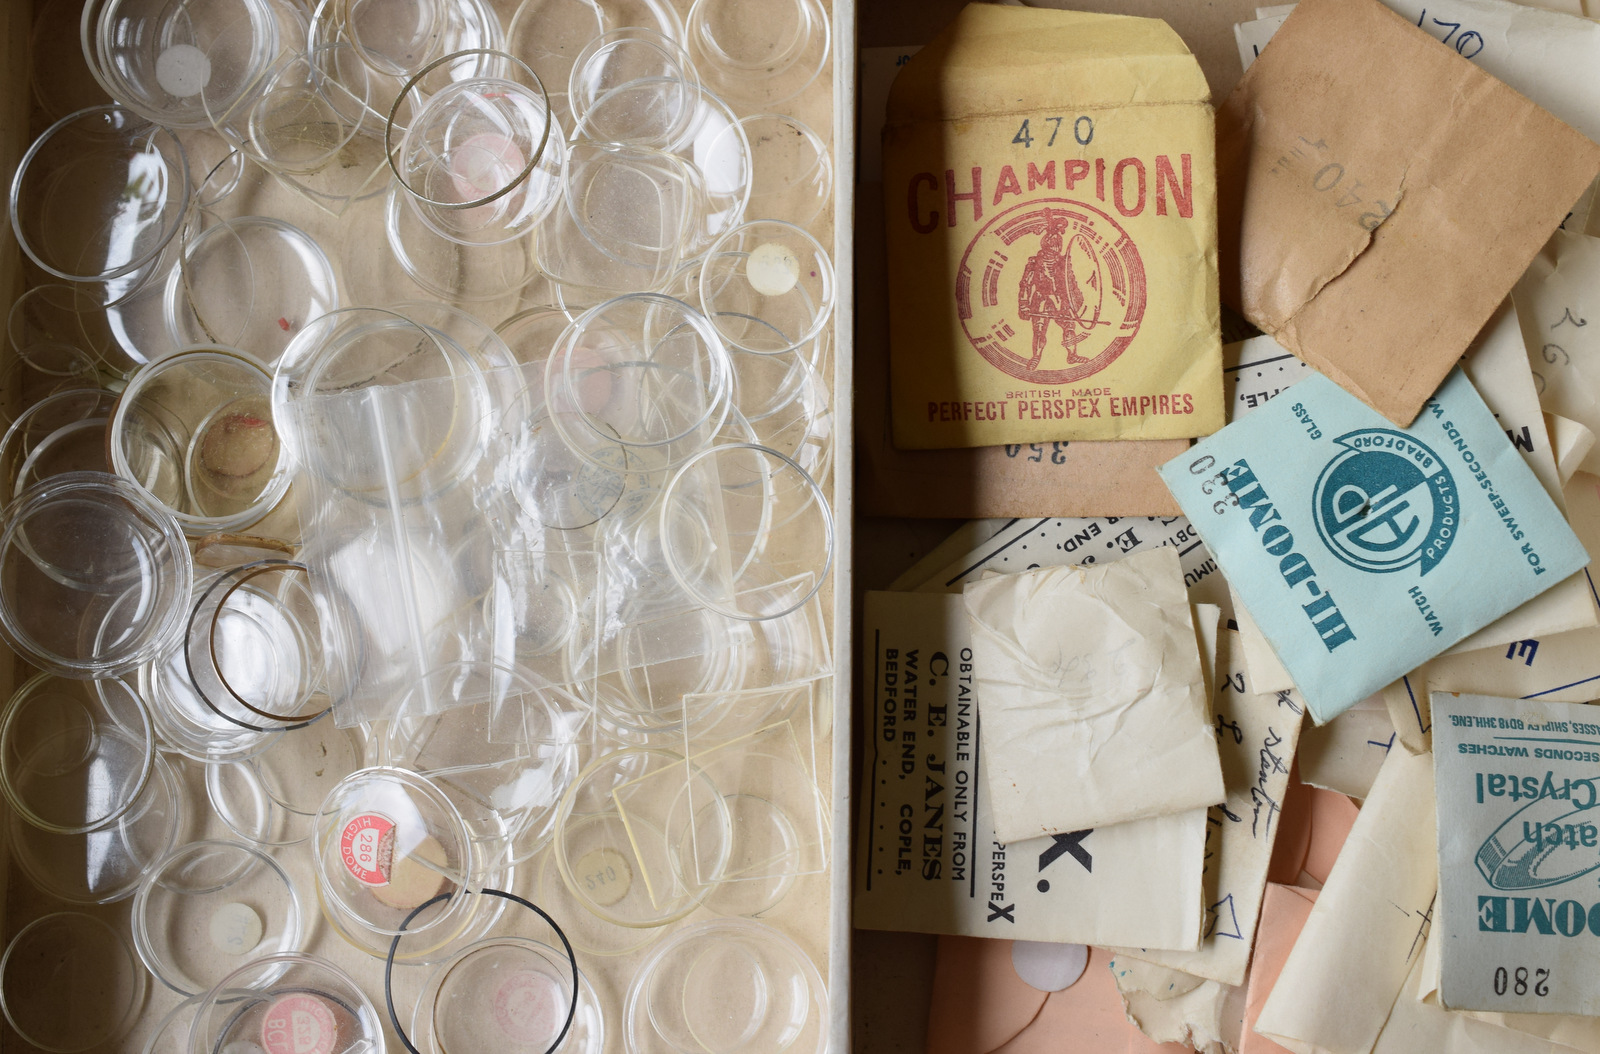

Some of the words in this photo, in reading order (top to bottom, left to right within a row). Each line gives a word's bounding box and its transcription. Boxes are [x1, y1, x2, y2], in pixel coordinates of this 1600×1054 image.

[1011, 115, 1096, 149] 470
[906, 152, 1194, 234] CHAMPION
[927, 399, 1009, 422] PERFECT
[1017, 397, 1102, 421] PERSPEX
[1109, 393, 1194, 417] EMPIRES
[1004, 389, 1062, 399] BRITISH
[1071, 387, 1112, 397] MADE
[1290, 402, 1323, 441] GLASS
[1353, 435, 1434, 469] BRADFORD
[1188, 454, 1240, 516] 330
[1442, 421, 1524, 541] SWEEP-SECONDS
[1426, 475, 1454, 560] PRODUCTS
[1055, 522, 1102, 554] END,
[1226, 458, 1357, 654] HI-DOME
[1521, 543, 1546, 576] FOR
[1407, 585, 1444, 637] WATCH
[902, 649, 919, 721] WATER
[928, 651, 949, 687] C.
[883, 648, 899, 742] BEDFORD
[955, 647, 973, 762] OBTAINABLE
[926, 702, 948, 738] E.
[898, 731, 916, 780] END,
[1457, 743, 1529, 758] WATCHES
[1534, 747, 1600, 763] SECONDS
[953, 770, 969, 823] ONLY
[1475, 770, 1597, 811] Crystal
[344, 816, 372, 841] HIGH
[922, 753, 945, 882] JANES
[1522, 821, 1598, 853] atch
[359, 833, 373, 863] 286
[895, 804, 914, 876] COPLE,
[951, 831, 967, 881] FROM
[342, 846, 368, 880] DOME
[1493, 966, 1550, 997] 280
